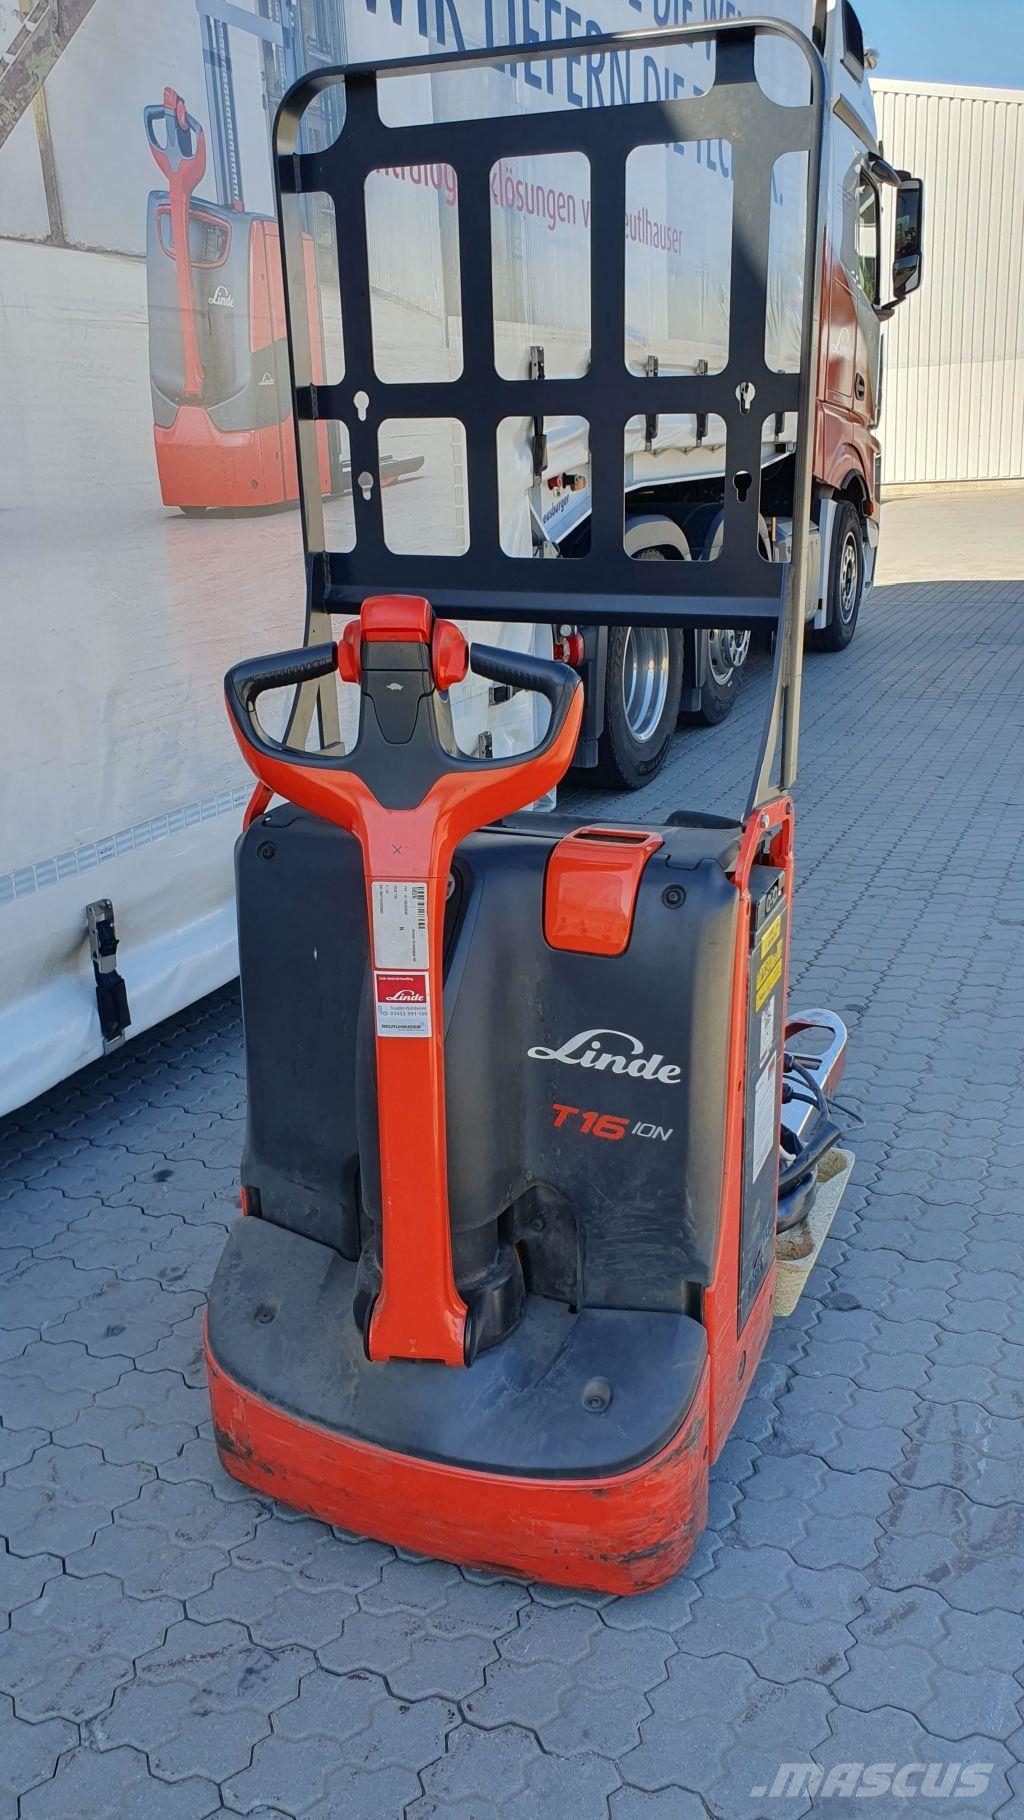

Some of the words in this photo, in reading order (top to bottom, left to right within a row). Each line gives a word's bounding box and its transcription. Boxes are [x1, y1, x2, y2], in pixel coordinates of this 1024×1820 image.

[625, 207, 683, 254] eutlhauser
[208, 285, 235, 308] Linde
[385, 989, 424, 1002] Linde
[527, 1029, 681, 1084] Linde
[631, 1121, 674, 1141] ION
